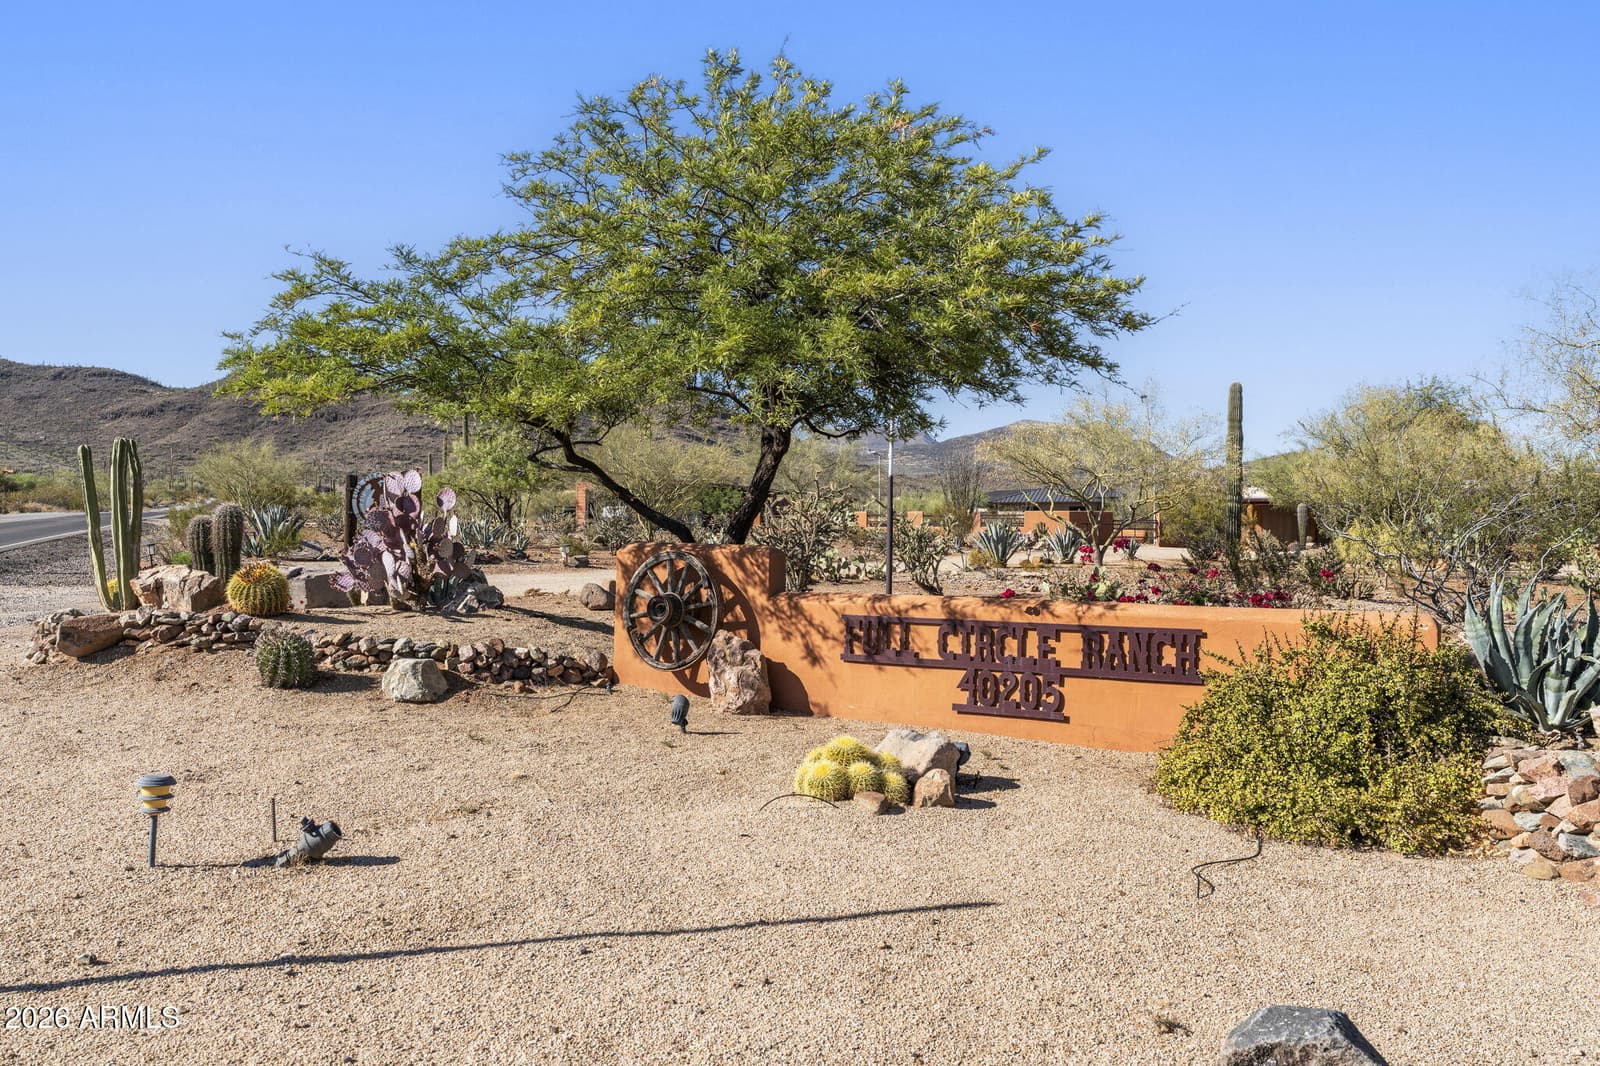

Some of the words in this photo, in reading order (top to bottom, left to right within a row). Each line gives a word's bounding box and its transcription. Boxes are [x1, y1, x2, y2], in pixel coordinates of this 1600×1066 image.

[845, 616, 920, 660] FULL
[937, 621, 1061, 670] CIRCLE
[1081, 628, 1202, 681] RANCH
[956, 667, 1067, 714] 40205
